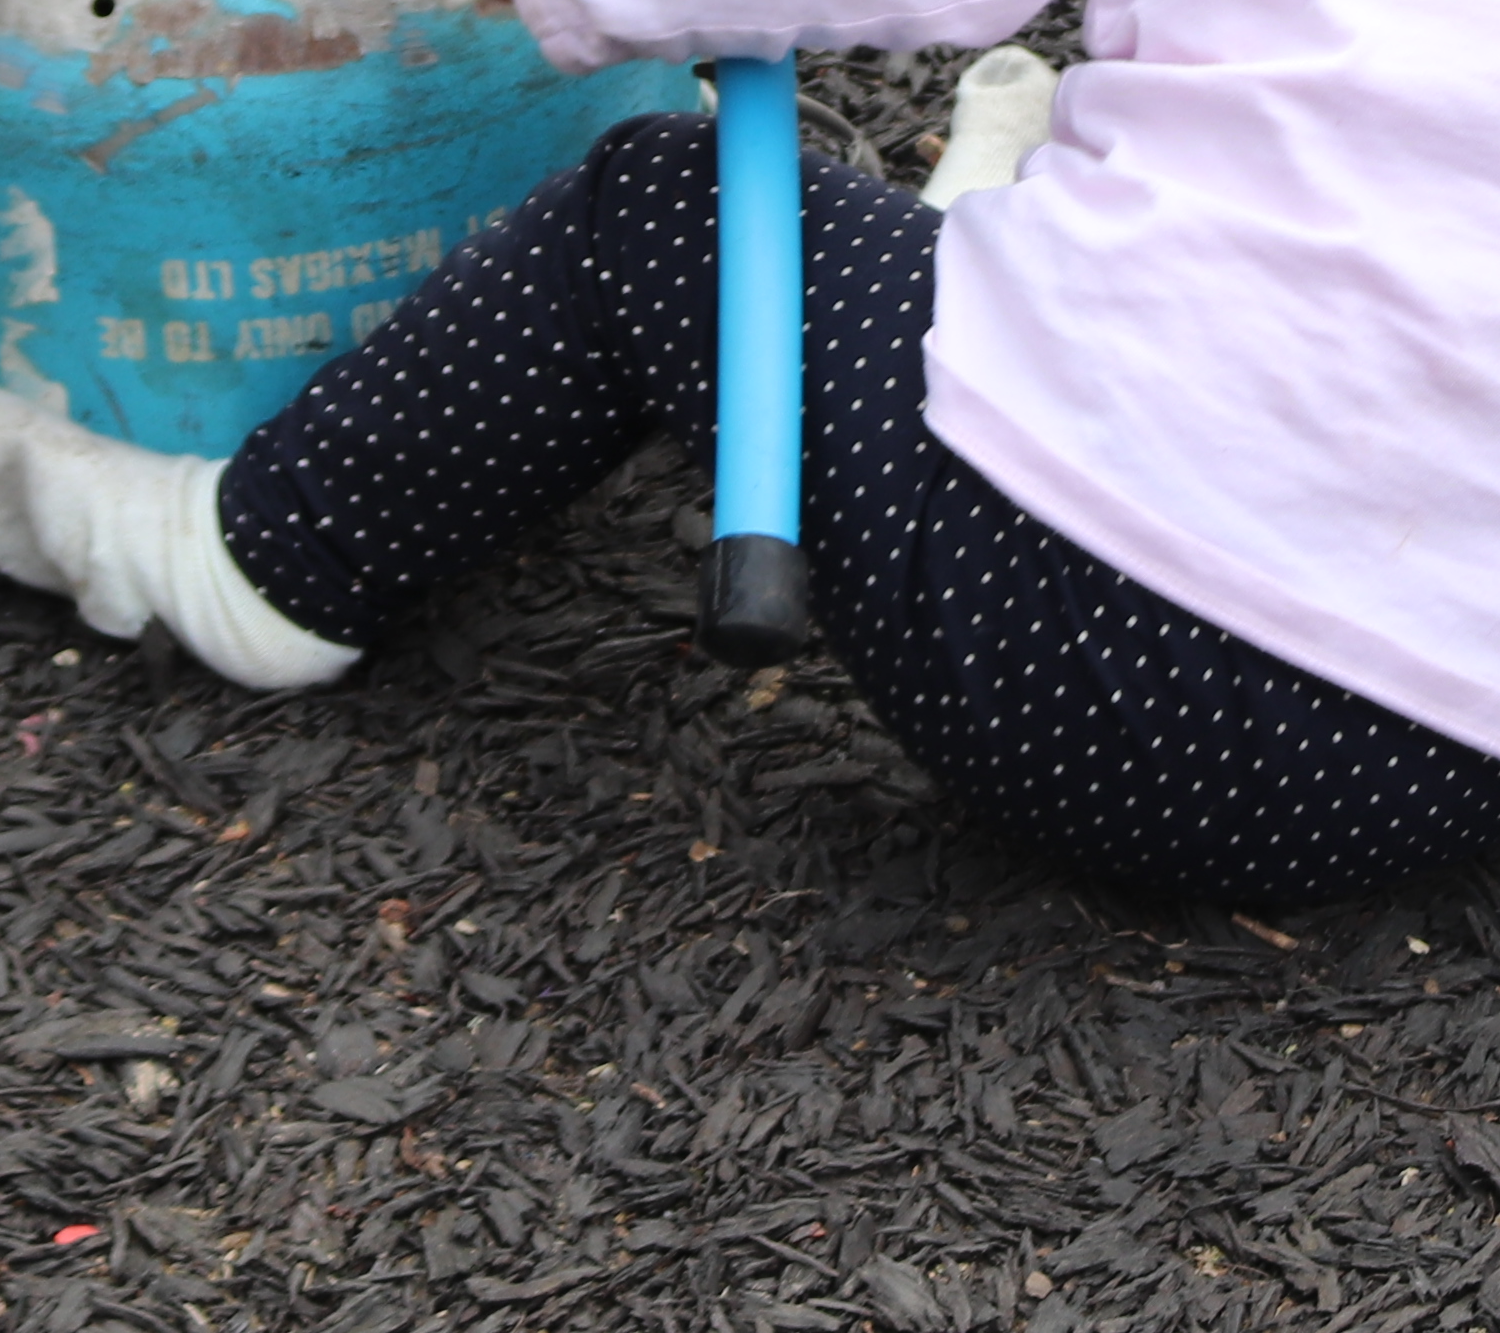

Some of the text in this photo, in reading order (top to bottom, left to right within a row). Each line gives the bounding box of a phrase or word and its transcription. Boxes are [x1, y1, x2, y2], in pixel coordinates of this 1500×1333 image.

[160, 226, 442, 300] MAXIGAS LTD
[98, 297, 408, 362] ND ONLY TO BE
